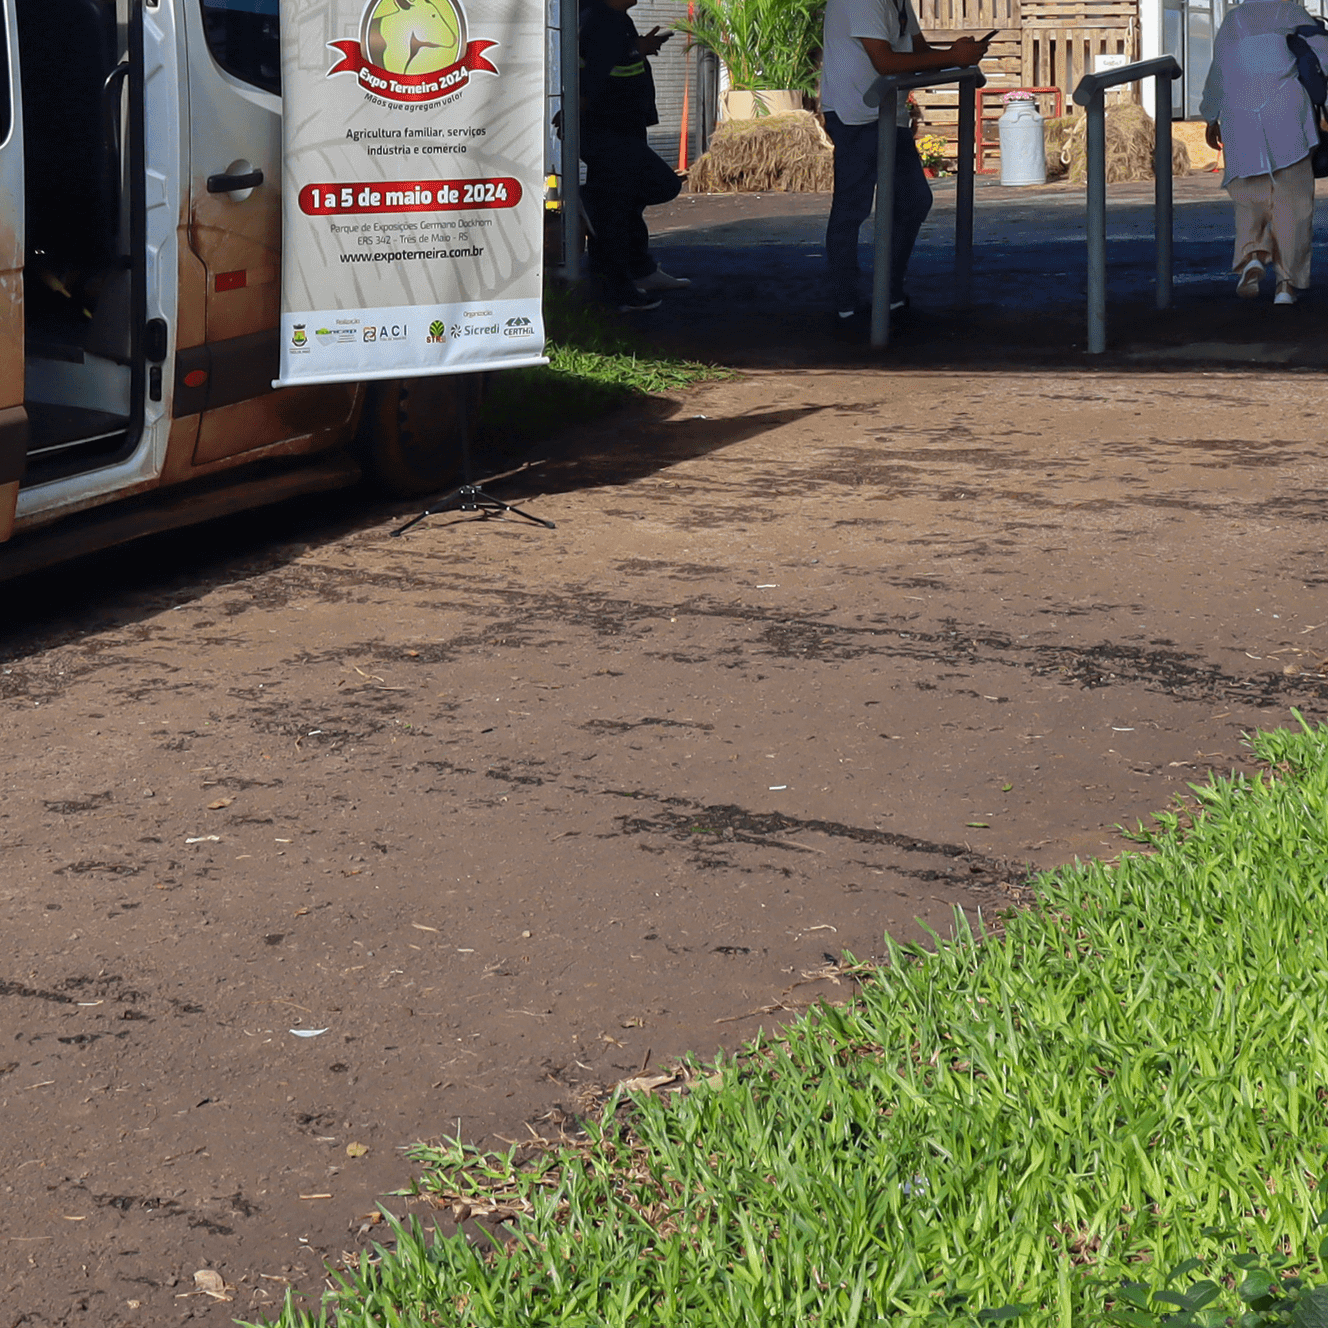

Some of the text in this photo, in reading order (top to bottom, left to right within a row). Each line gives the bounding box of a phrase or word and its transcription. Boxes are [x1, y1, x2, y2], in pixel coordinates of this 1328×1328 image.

[359, 65, 468, 94] Expo Terneira 2024
[364, 91, 463, 112] Mãos que agregam valor
[346, 126, 486, 142] Agricultura familiar, serviços
[367, 144, 410, 155] indústria
[421, 143, 467, 154] comércio
[311, 183, 507, 208] 1 a 5 de maio de 2024
[330, 224, 360, 234] Parque
[360, 223, 372, 232] de
[373, 220, 418, 234] Exposições
[419, 220, 456, 229] Germano
[357, 236, 373, 245] ERS
[374, 236, 391, 244] 342
[399, 234, 417, 243] Três
[418, 234, 429, 243] de
[431, 233, 451, 242] Maio
[458, 232, 469, 241] RS
[340, 245, 484, 263] www.expoterneira.com.br
[380, 325, 407, 338] ACI
[464, 323, 500, 335] Sicredi
